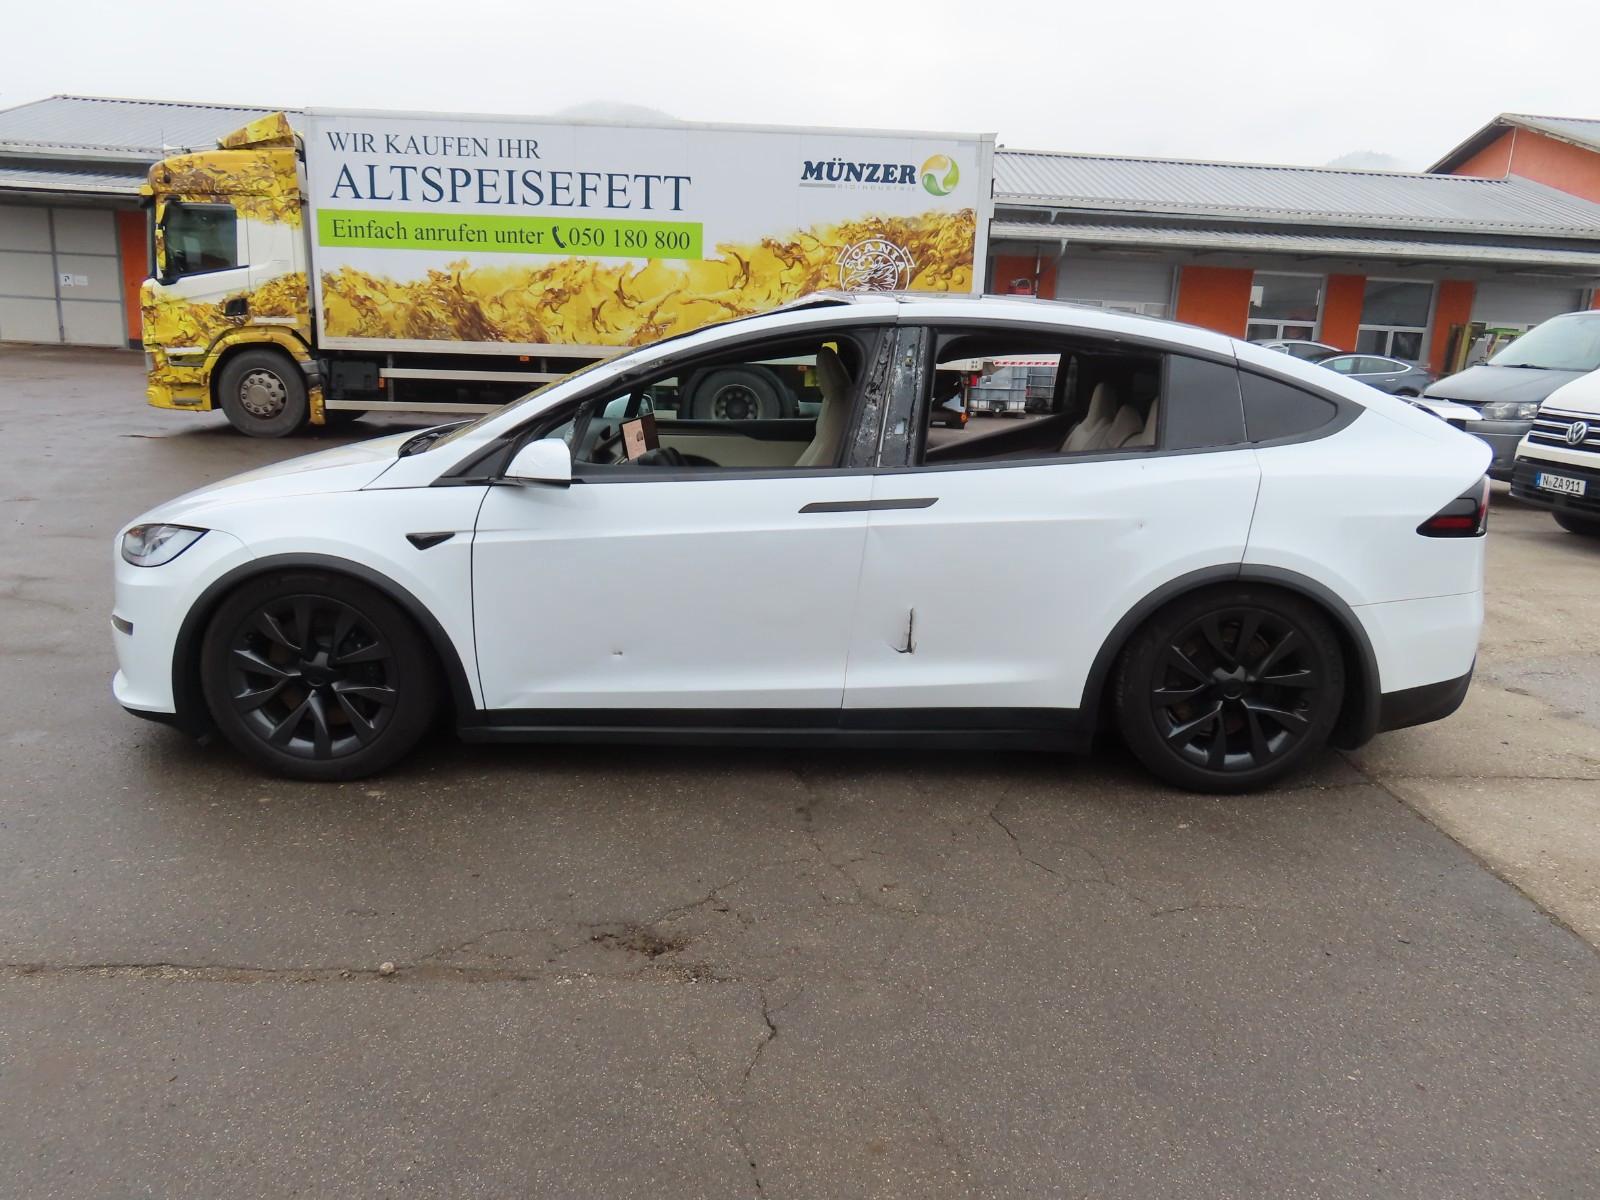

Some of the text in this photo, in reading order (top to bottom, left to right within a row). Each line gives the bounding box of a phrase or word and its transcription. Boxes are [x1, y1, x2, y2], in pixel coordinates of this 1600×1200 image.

[326, 131, 541, 160] WIR KAUFEN IHR
[330, 162, 692, 211] ALTSPEISEFETT
[801, 157, 917, 185] MÜNZER
[332, 219, 690, 250] Einfach anrufen unter 050 180 800
[845, 242, 906, 273] SCANIA
